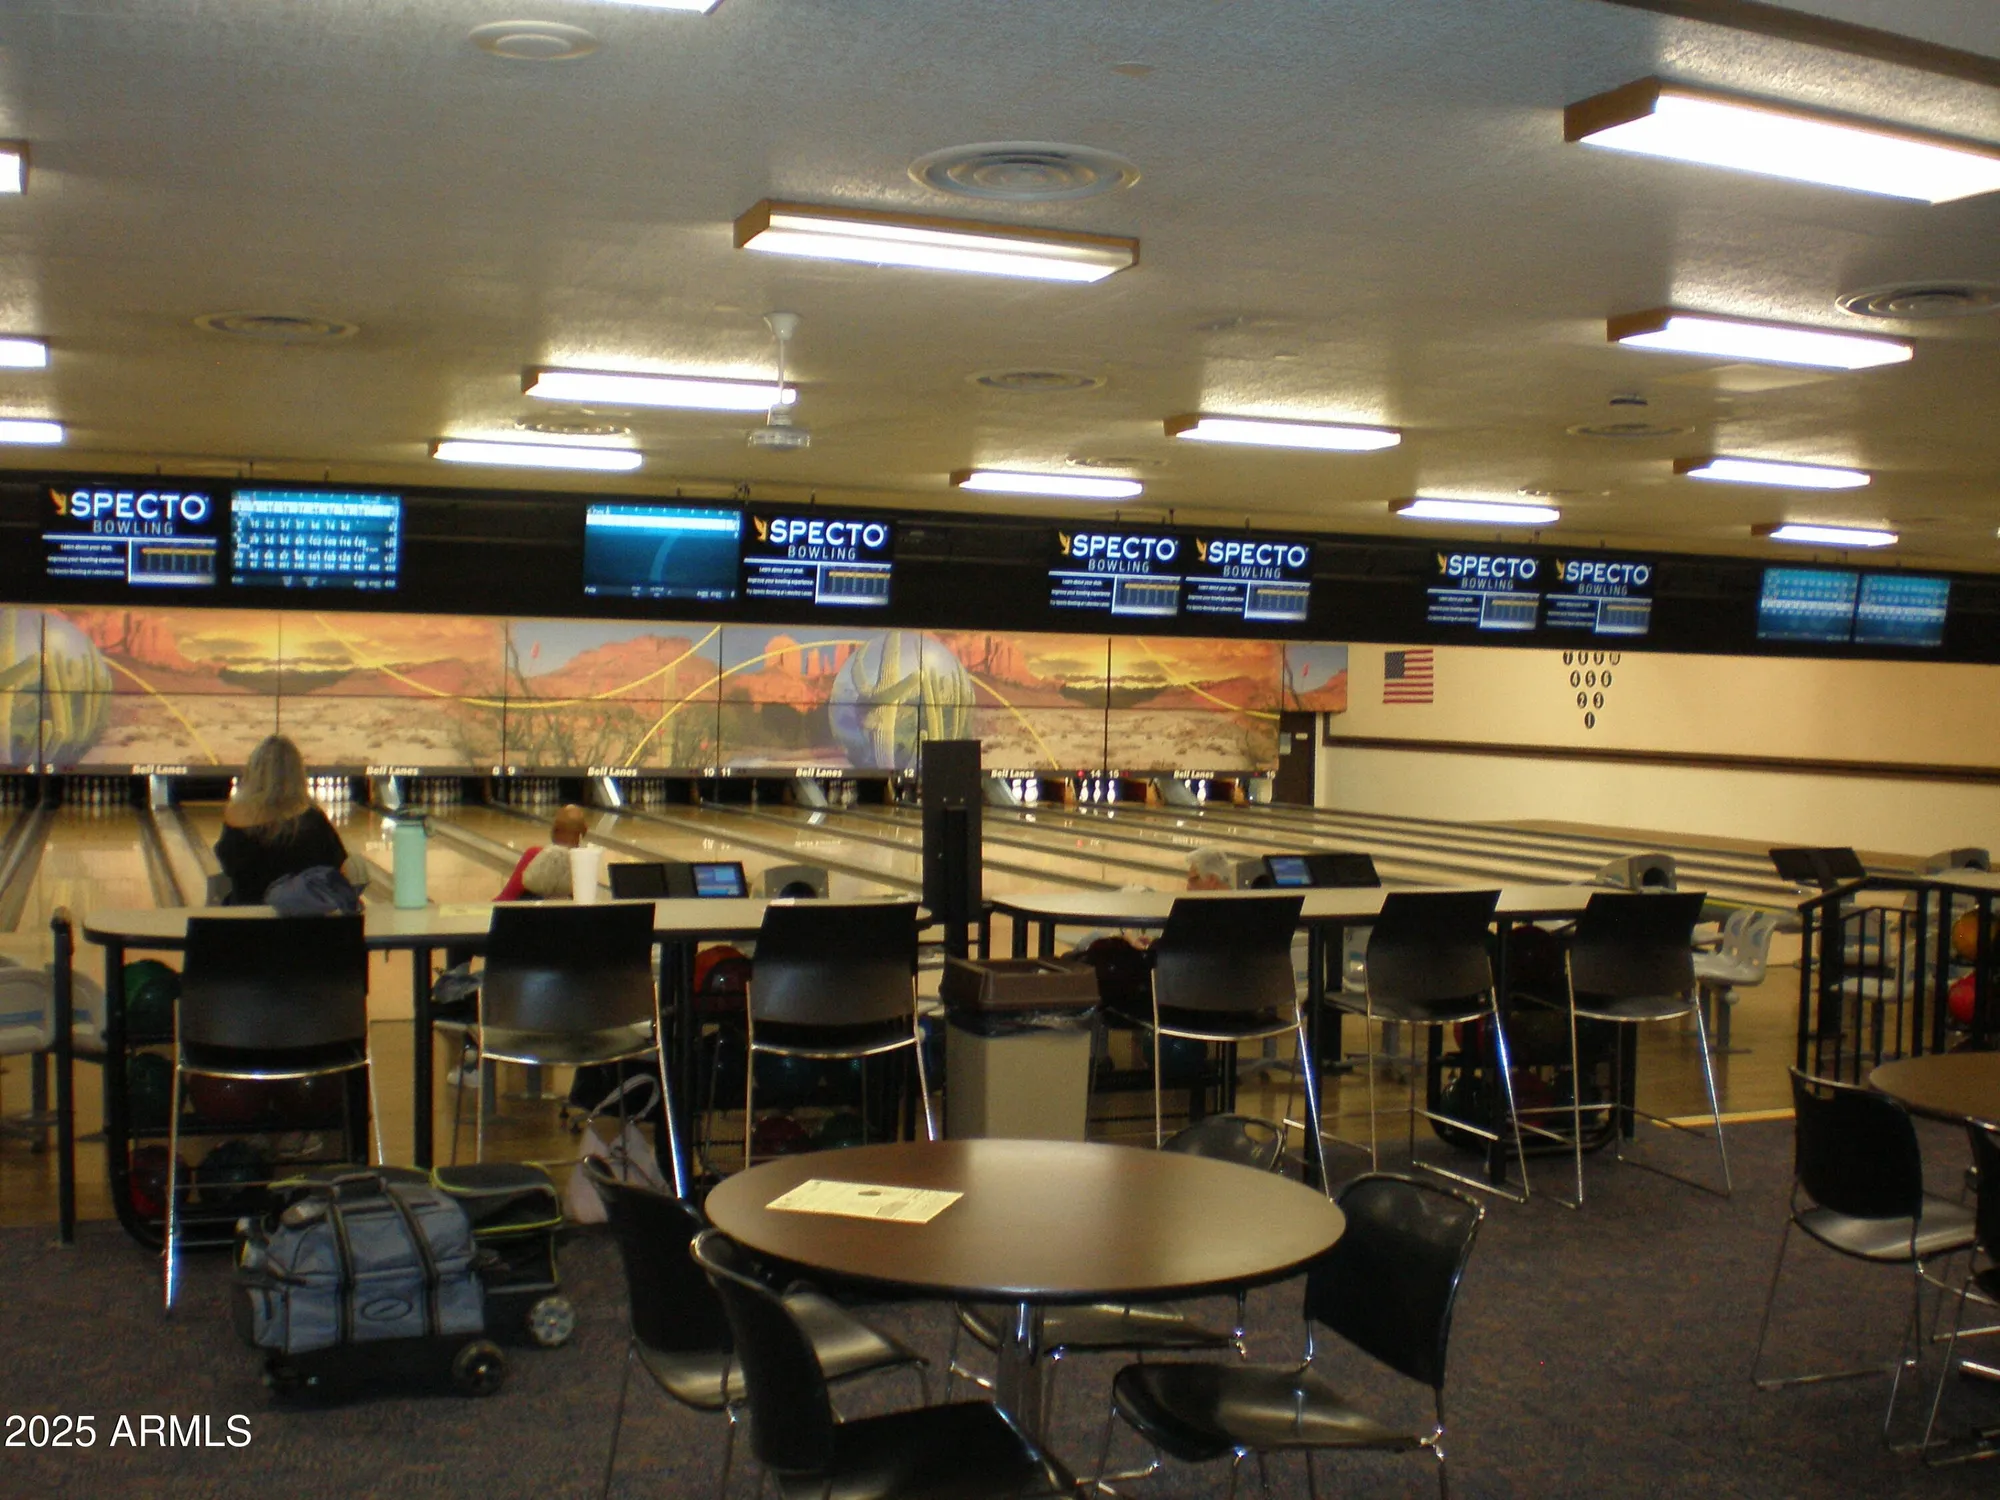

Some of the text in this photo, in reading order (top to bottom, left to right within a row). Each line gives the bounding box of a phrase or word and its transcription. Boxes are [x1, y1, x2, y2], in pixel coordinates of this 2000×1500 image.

[70, 490, 206, 521] SPECTO
[92, 520, 174, 536] BOWLING
[770, 519, 885, 548] SPECTO
[788, 545, 856, 561] BOWLING
[1072, 533, 1176, 561] SPECTO
[1208, 541, 1306, 568] SPECTO
[1088, 559, 1150, 574] BOWLING
[1223, 565, 1282, 579] BOWLING
[1446, 554, 1536, 579] SPECTO
[1564, 561, 1649, 586] SPECTO
[1461, 577, 1514, 592] BOWLING
[1577, 582, 1629, 597] BOWLING
[156, 765, 188, 775] Lanes
[389, 766, 419, 776] Lanes
[609, 767, 637, 777] Lanes
[816, 769, 842, 778] Lanes
[1010, 769, 1035, 779] Lanes
[1191, 771, 1215, 779] Lanes
